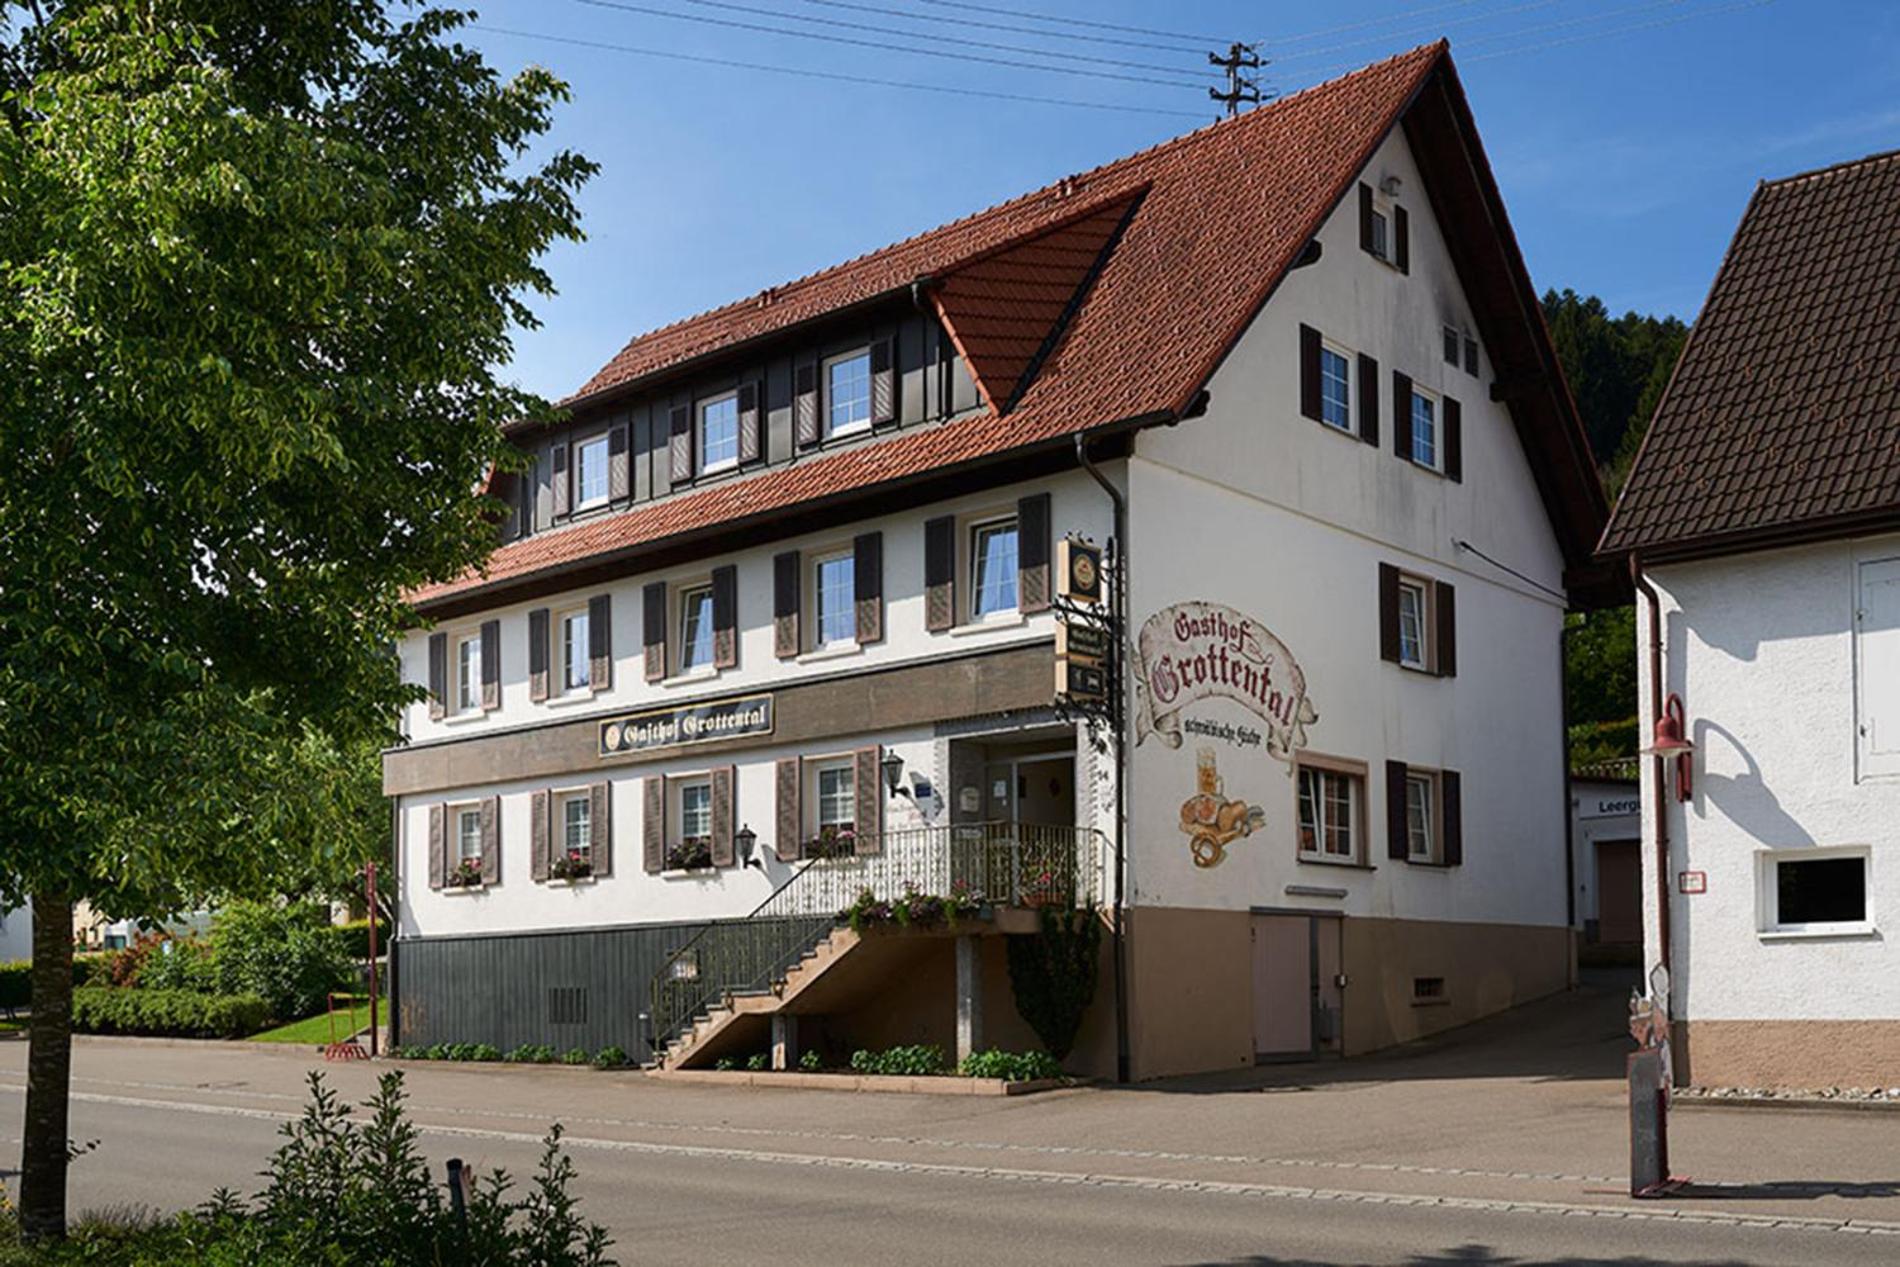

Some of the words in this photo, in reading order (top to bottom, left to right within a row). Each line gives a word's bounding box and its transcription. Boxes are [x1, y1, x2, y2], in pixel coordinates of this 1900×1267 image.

[1174, 612, 1258, 657] Gasthof
[1152, 644, 1294, 727] Grottental
[624, 717, 679, 745] Gasthof
[682, 704, 766, 735] Grottental
